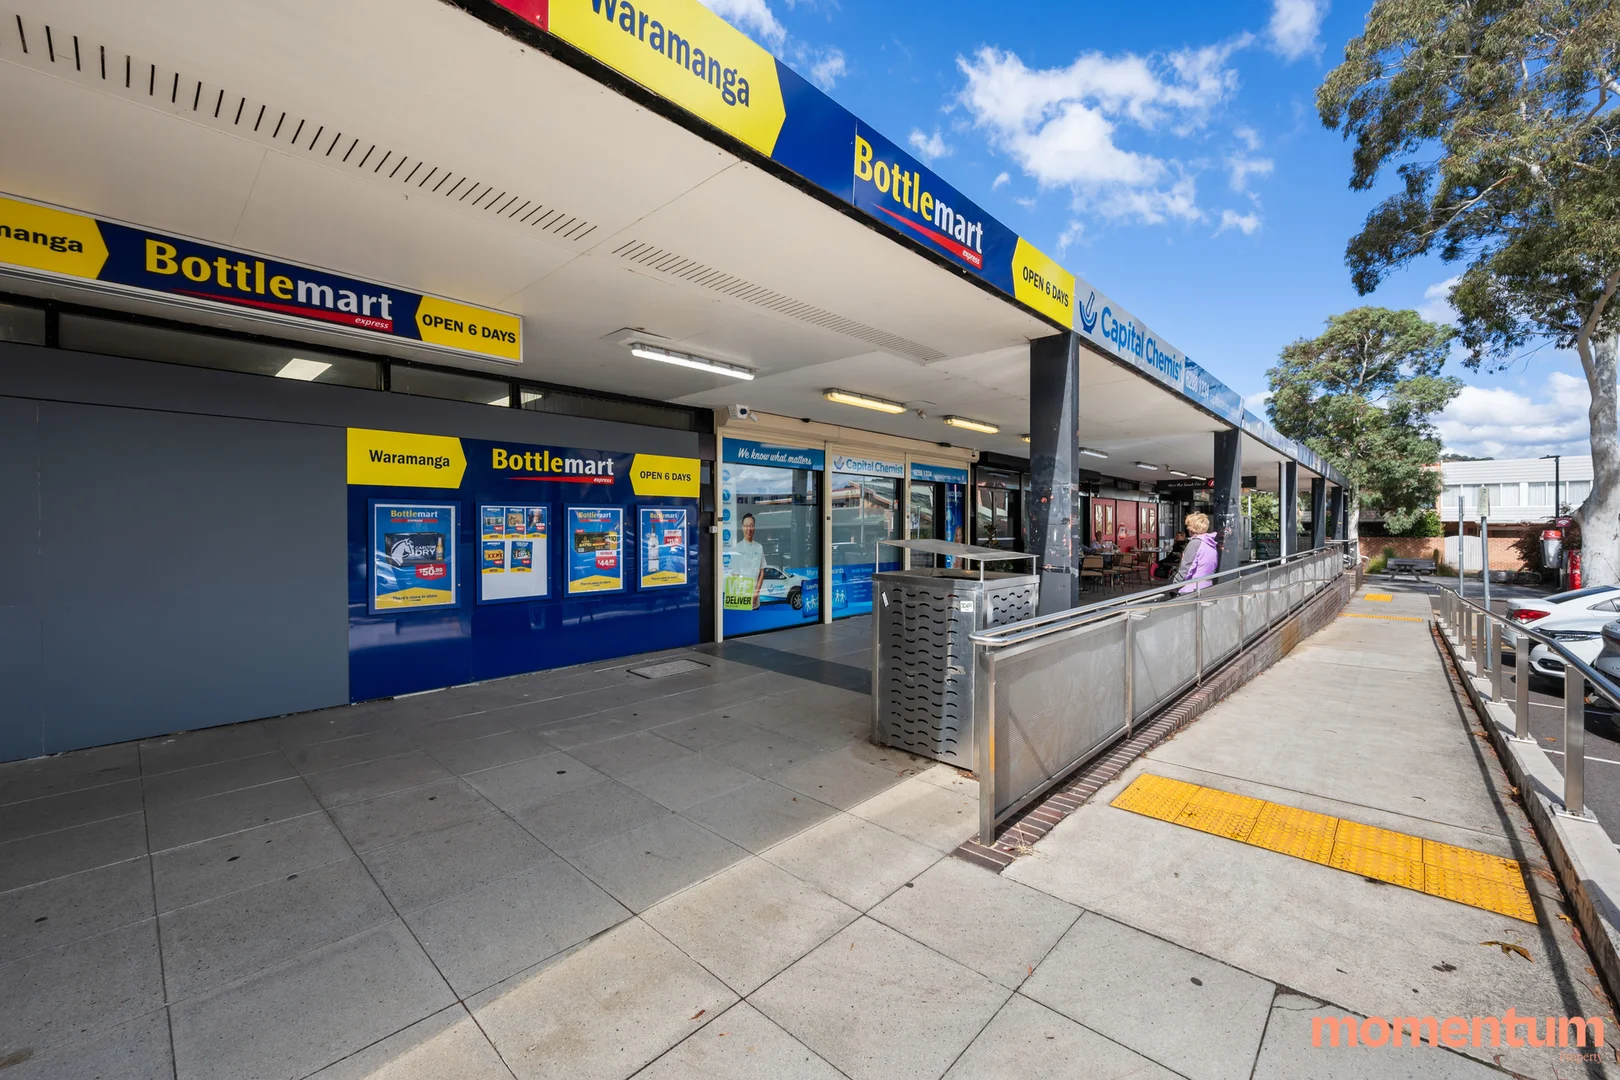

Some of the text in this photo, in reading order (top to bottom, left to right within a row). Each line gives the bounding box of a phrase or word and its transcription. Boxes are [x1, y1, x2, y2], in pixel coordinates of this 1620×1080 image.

[855, 134, 983, 254] Bottlemart
[962, 249, 980, 265] express
[145, 238, 394, 320] Bottlemart
[1022, 266, 1069, 308] OPEN 6 DAYS
[355, 317, 389, 329] express
[422, 314, 516, 344] OPEN 6 DAYS
[1101, 306, 1144, 358] Capital
[369, 449, 450, 469] Waramanga
[492, 448, 614, 476] Bottlemart
[738, 448, 812, 465] We know what matters
[846, 459, 903, 474] Capital Chemist
[640, 471, 691, 482] OPEN 6 DAYS
[391, 510, 438, 518] Bottlemart
[728, 576, 751, 596] WE
[726, 596, 751, 605] DELIVER
